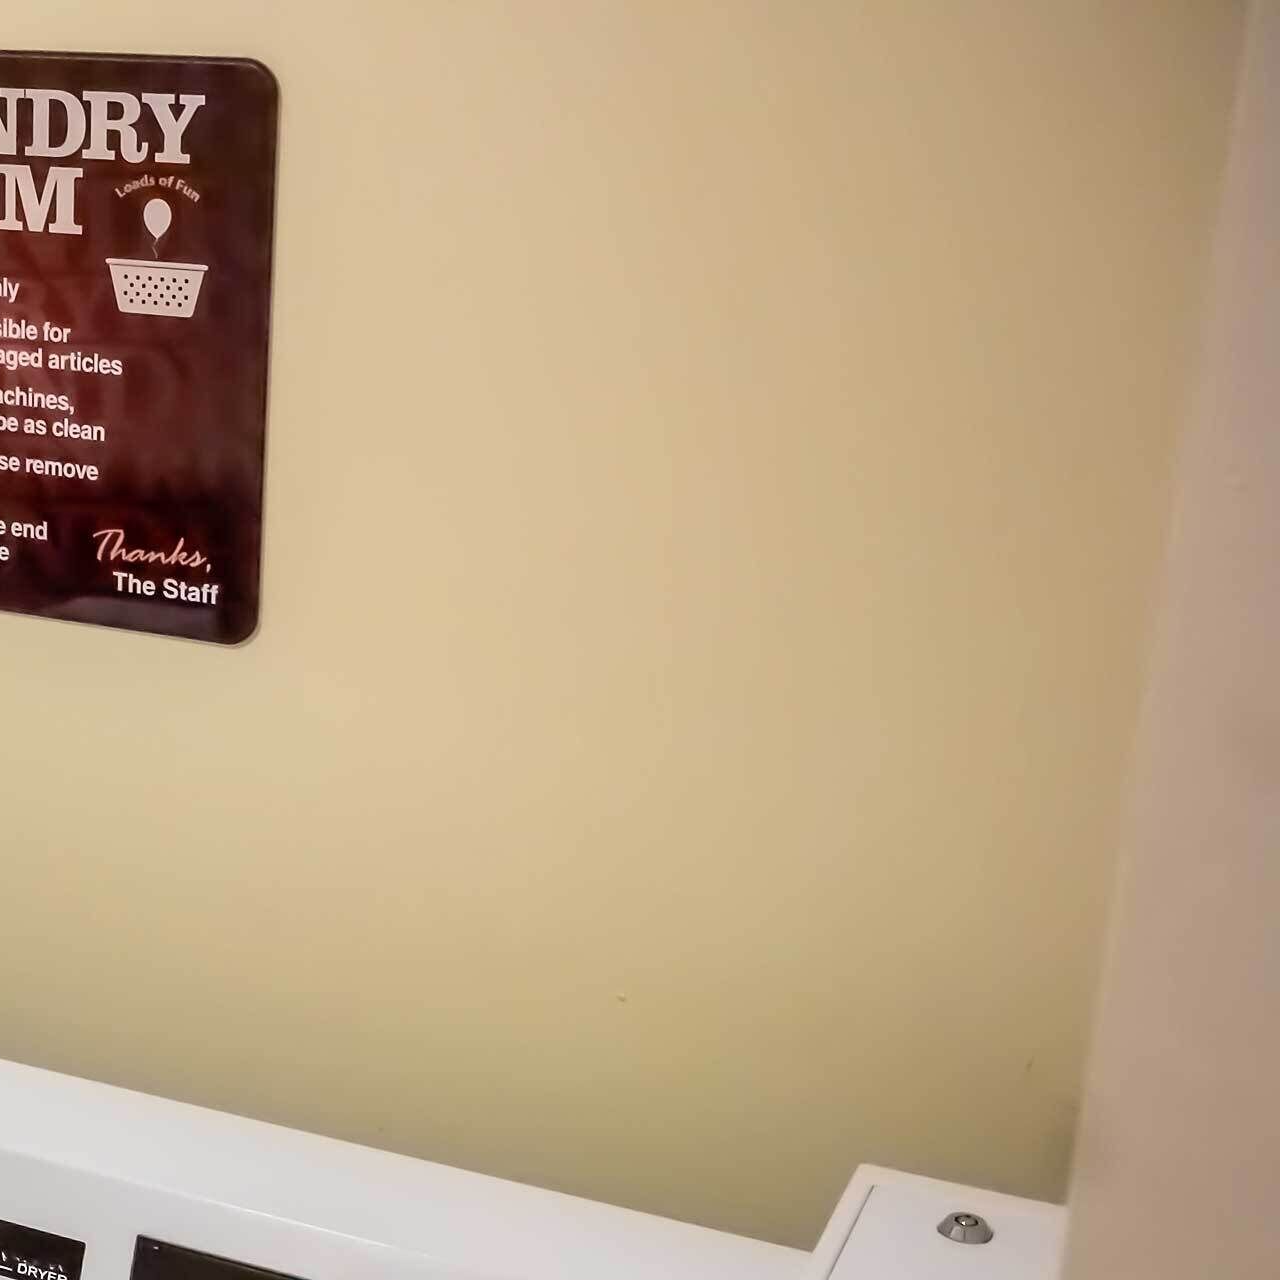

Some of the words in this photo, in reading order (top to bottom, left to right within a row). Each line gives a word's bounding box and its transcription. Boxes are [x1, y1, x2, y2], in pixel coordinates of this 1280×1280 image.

[114, 174, 156, 199] Loads
[158, 175, 175, 190] of
[176, 178, 201, 203] Fun
[42, 321, 72, 343] for
[47, 351, 123, 376] articles
[23, 416, 47, 436] as
[51, 418, 106, 442] clean
[25, 457, 100, 481] remove
[10, 521, 49, 541] end
[92, 528, 213, 573] Thanks,
[112, 571, 156, 597] The
[162, 578, 220, 605] Staff
